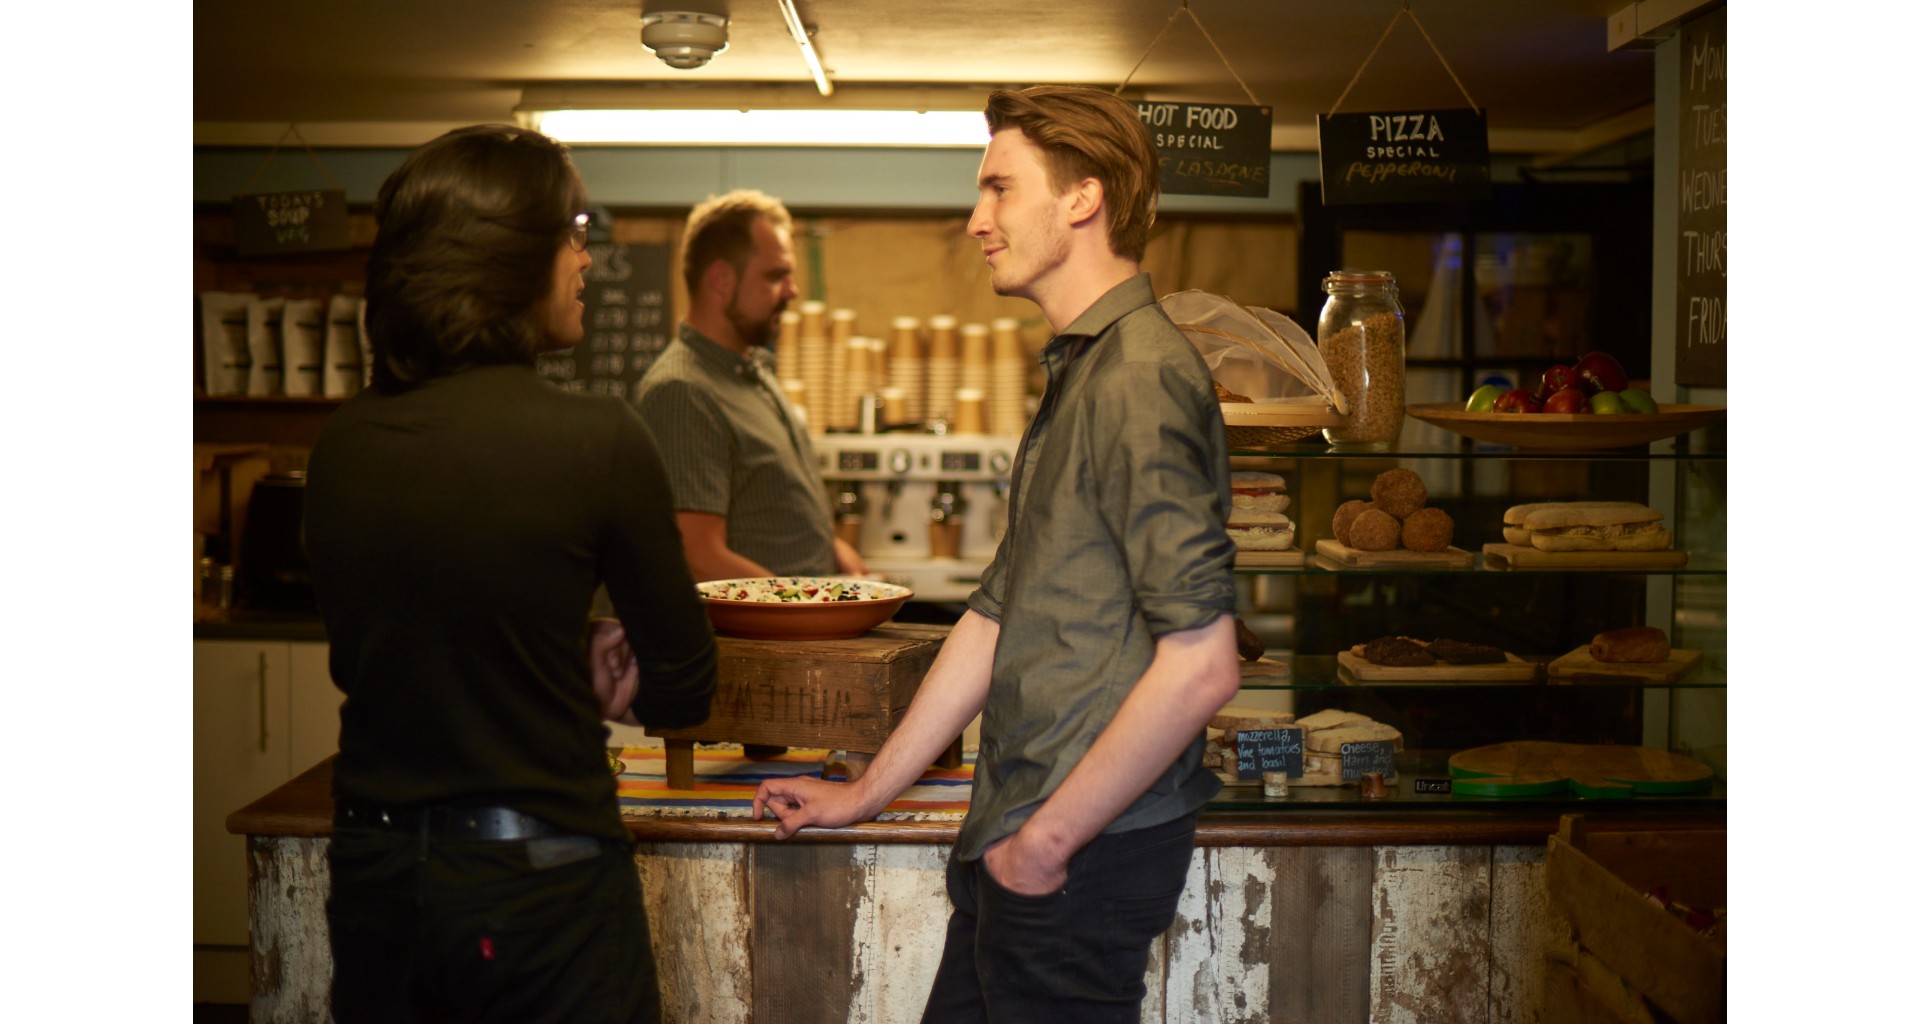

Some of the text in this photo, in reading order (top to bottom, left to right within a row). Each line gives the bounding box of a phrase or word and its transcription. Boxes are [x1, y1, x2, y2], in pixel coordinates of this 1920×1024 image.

[1137, 104, 1238, 130] HOT FOOD
[1369, 114, 1444, 142] PIZZA
[1156, 133, 1224, 149] SPECIAL
[1367, 146, 1439, 159] SPECIAL
[1175, 159, 1265, 184] LASAGNE
[1345, 160, 1457, 183] PEPPERONI
[267, 206, 310, 227] SOUP
[1257, 742, 1301, 756] tomatoes
[1341, 743, 1385, 755] Cheese,
[1238, 755, 1286, 771] and basil
[1343, 753, 1393, 767] Ham and
